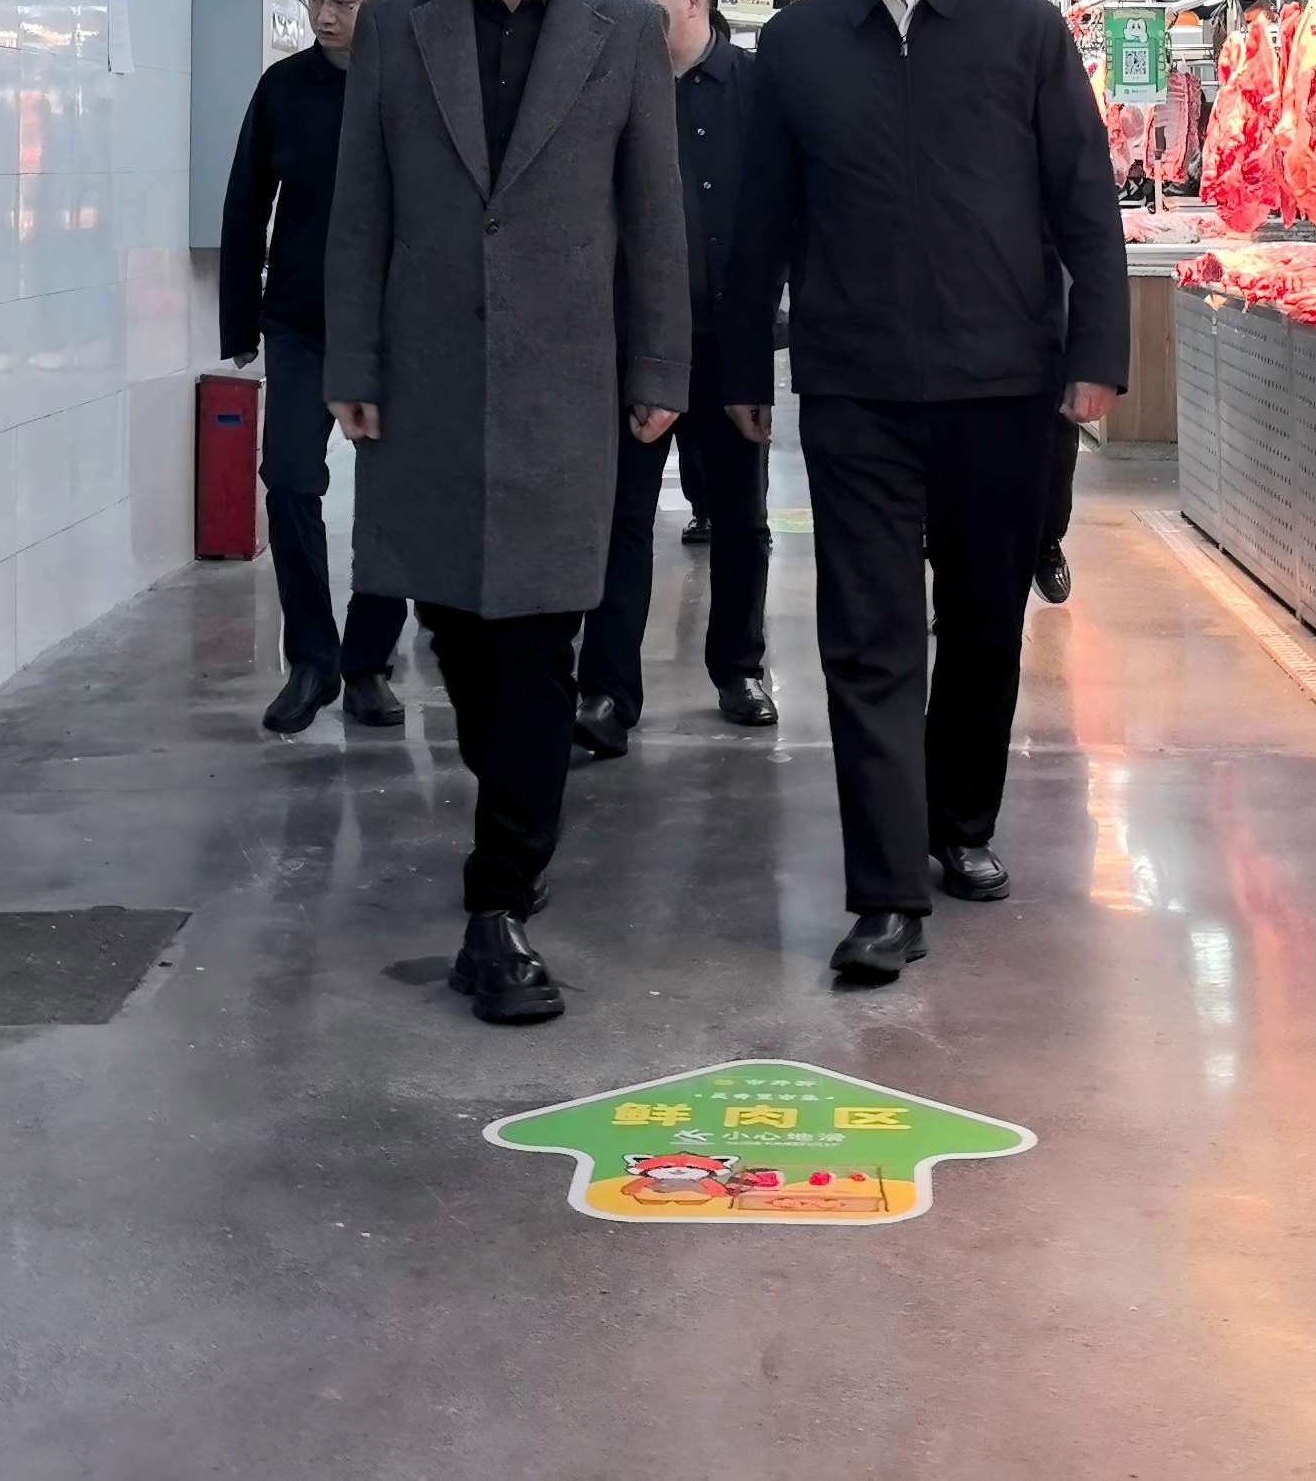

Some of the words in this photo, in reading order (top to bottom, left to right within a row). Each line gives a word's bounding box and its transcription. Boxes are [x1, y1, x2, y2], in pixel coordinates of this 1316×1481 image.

[611, 1101, 912, 1130] 鲜肉区
[722, 1131, 846, 1142] 小心地滑
